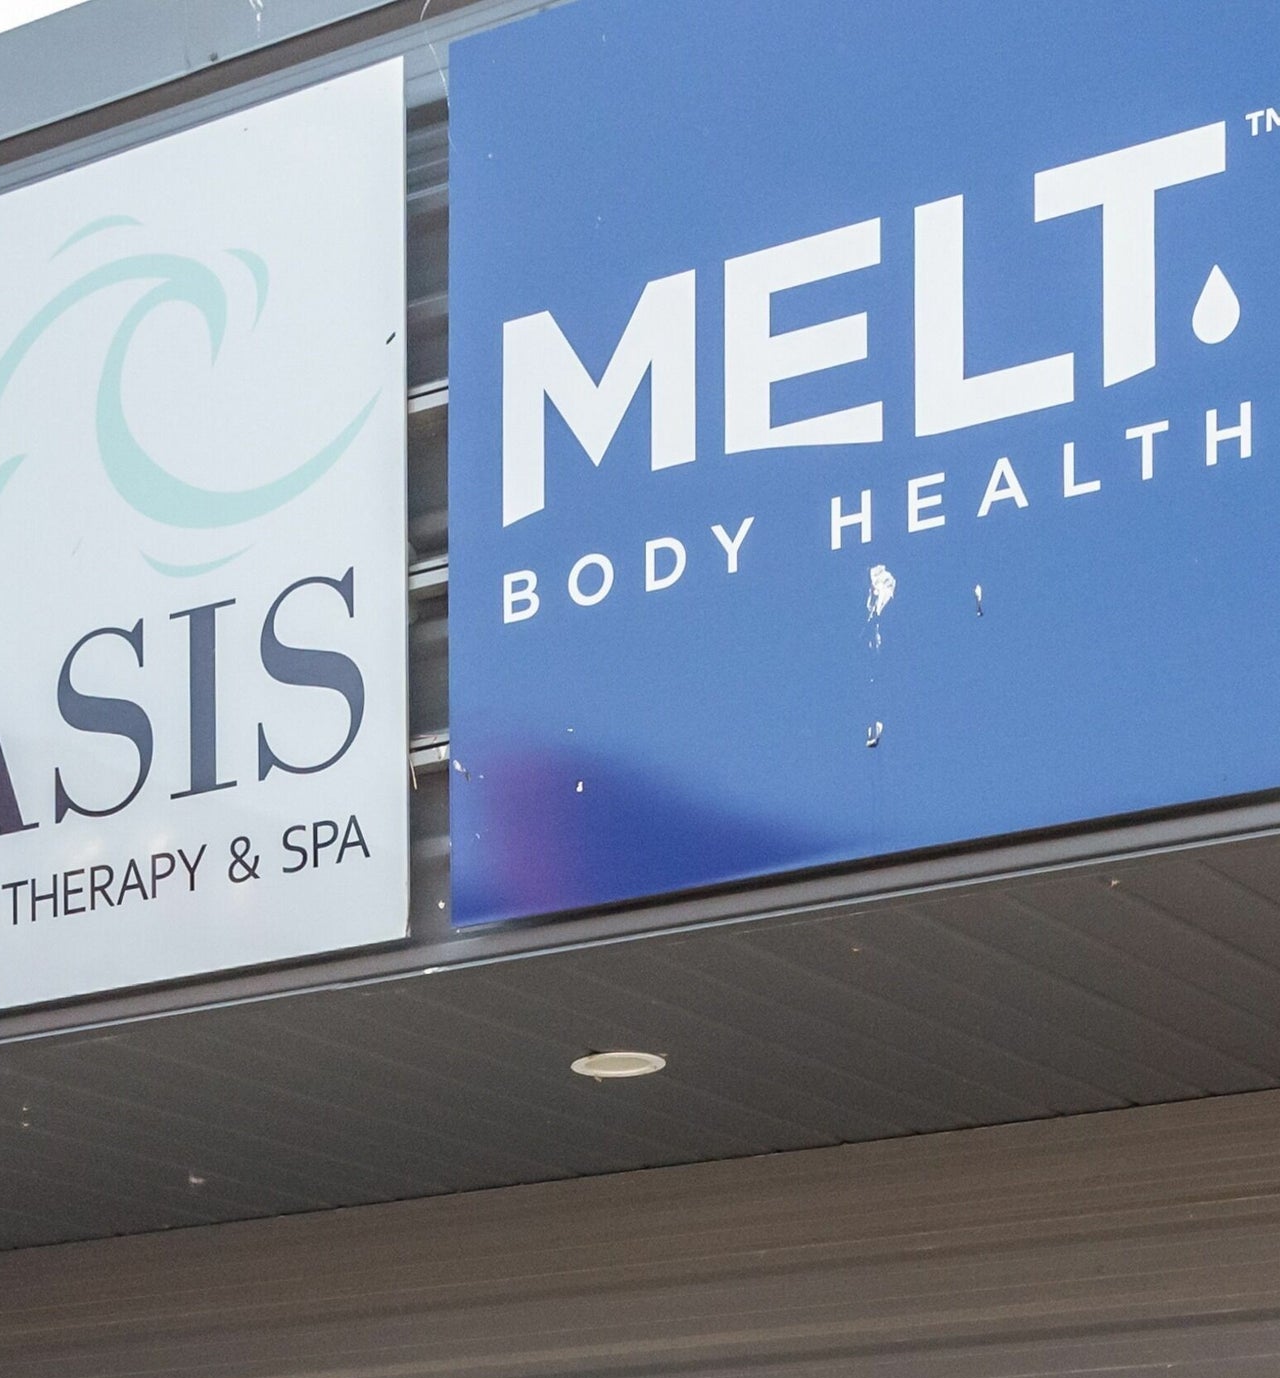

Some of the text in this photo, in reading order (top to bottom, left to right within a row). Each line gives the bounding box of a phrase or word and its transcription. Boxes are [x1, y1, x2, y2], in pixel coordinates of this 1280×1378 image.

[503, 401, 1252, 625] BODY HEALTH
[2, 844, 208, 925] THERAPY
[227, 836, 261, 883] &
[282, 814, 371, 874] SPA
